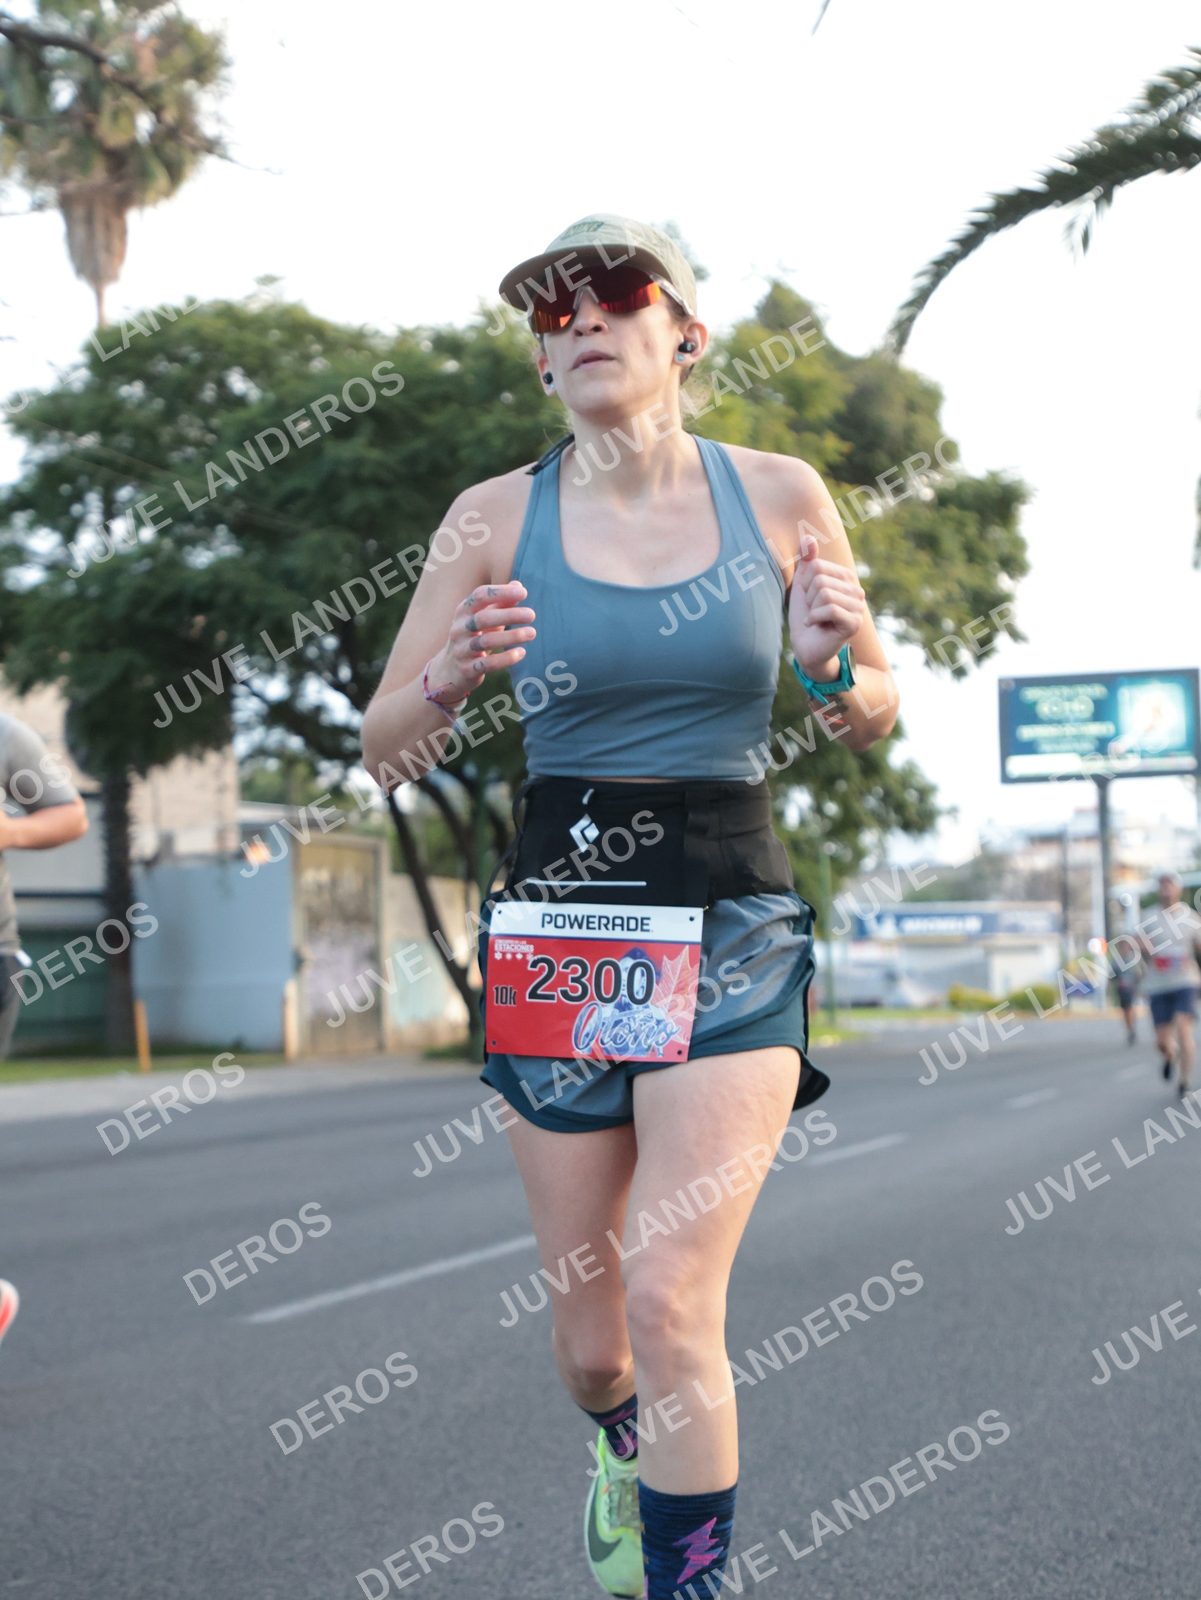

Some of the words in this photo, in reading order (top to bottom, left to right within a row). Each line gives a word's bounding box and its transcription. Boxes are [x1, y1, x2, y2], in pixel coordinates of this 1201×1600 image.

[541, 912, 651, 932] POWERADE
[526, 955, 656, 1005] 2300
[493, 985, 517, 1007] 10k
